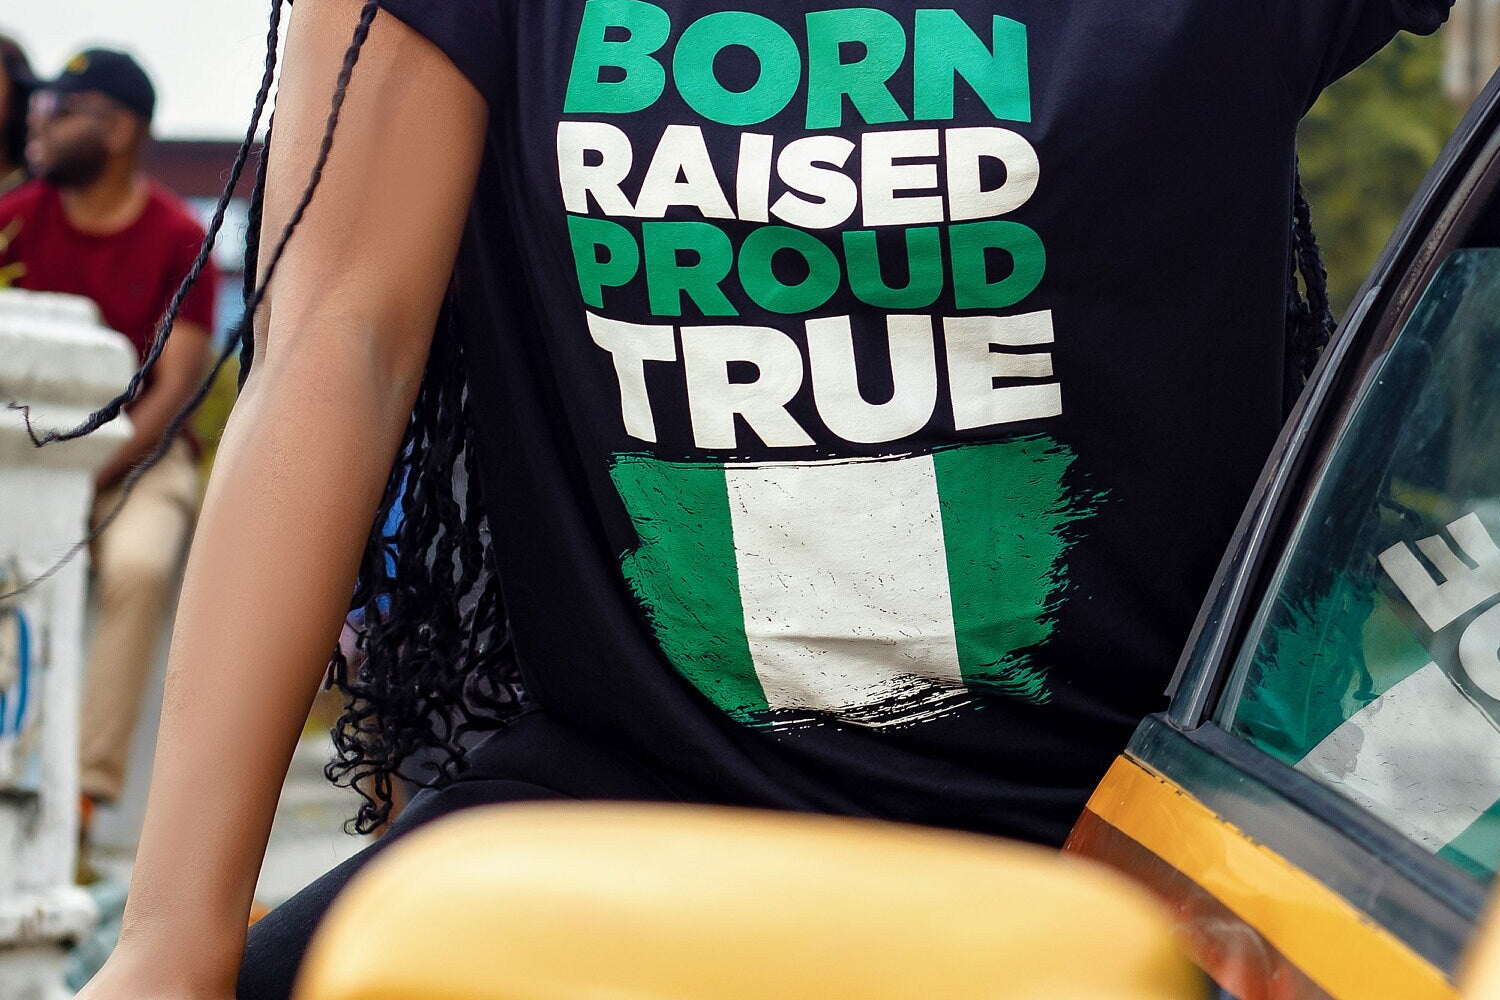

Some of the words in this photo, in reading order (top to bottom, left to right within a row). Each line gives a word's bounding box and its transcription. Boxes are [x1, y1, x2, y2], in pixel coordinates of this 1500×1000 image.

[557, 121, 1040, 229] RAISED
[567, 214, 1046, 316] PROUD
[586, 309, 1062, 449] TRUE
